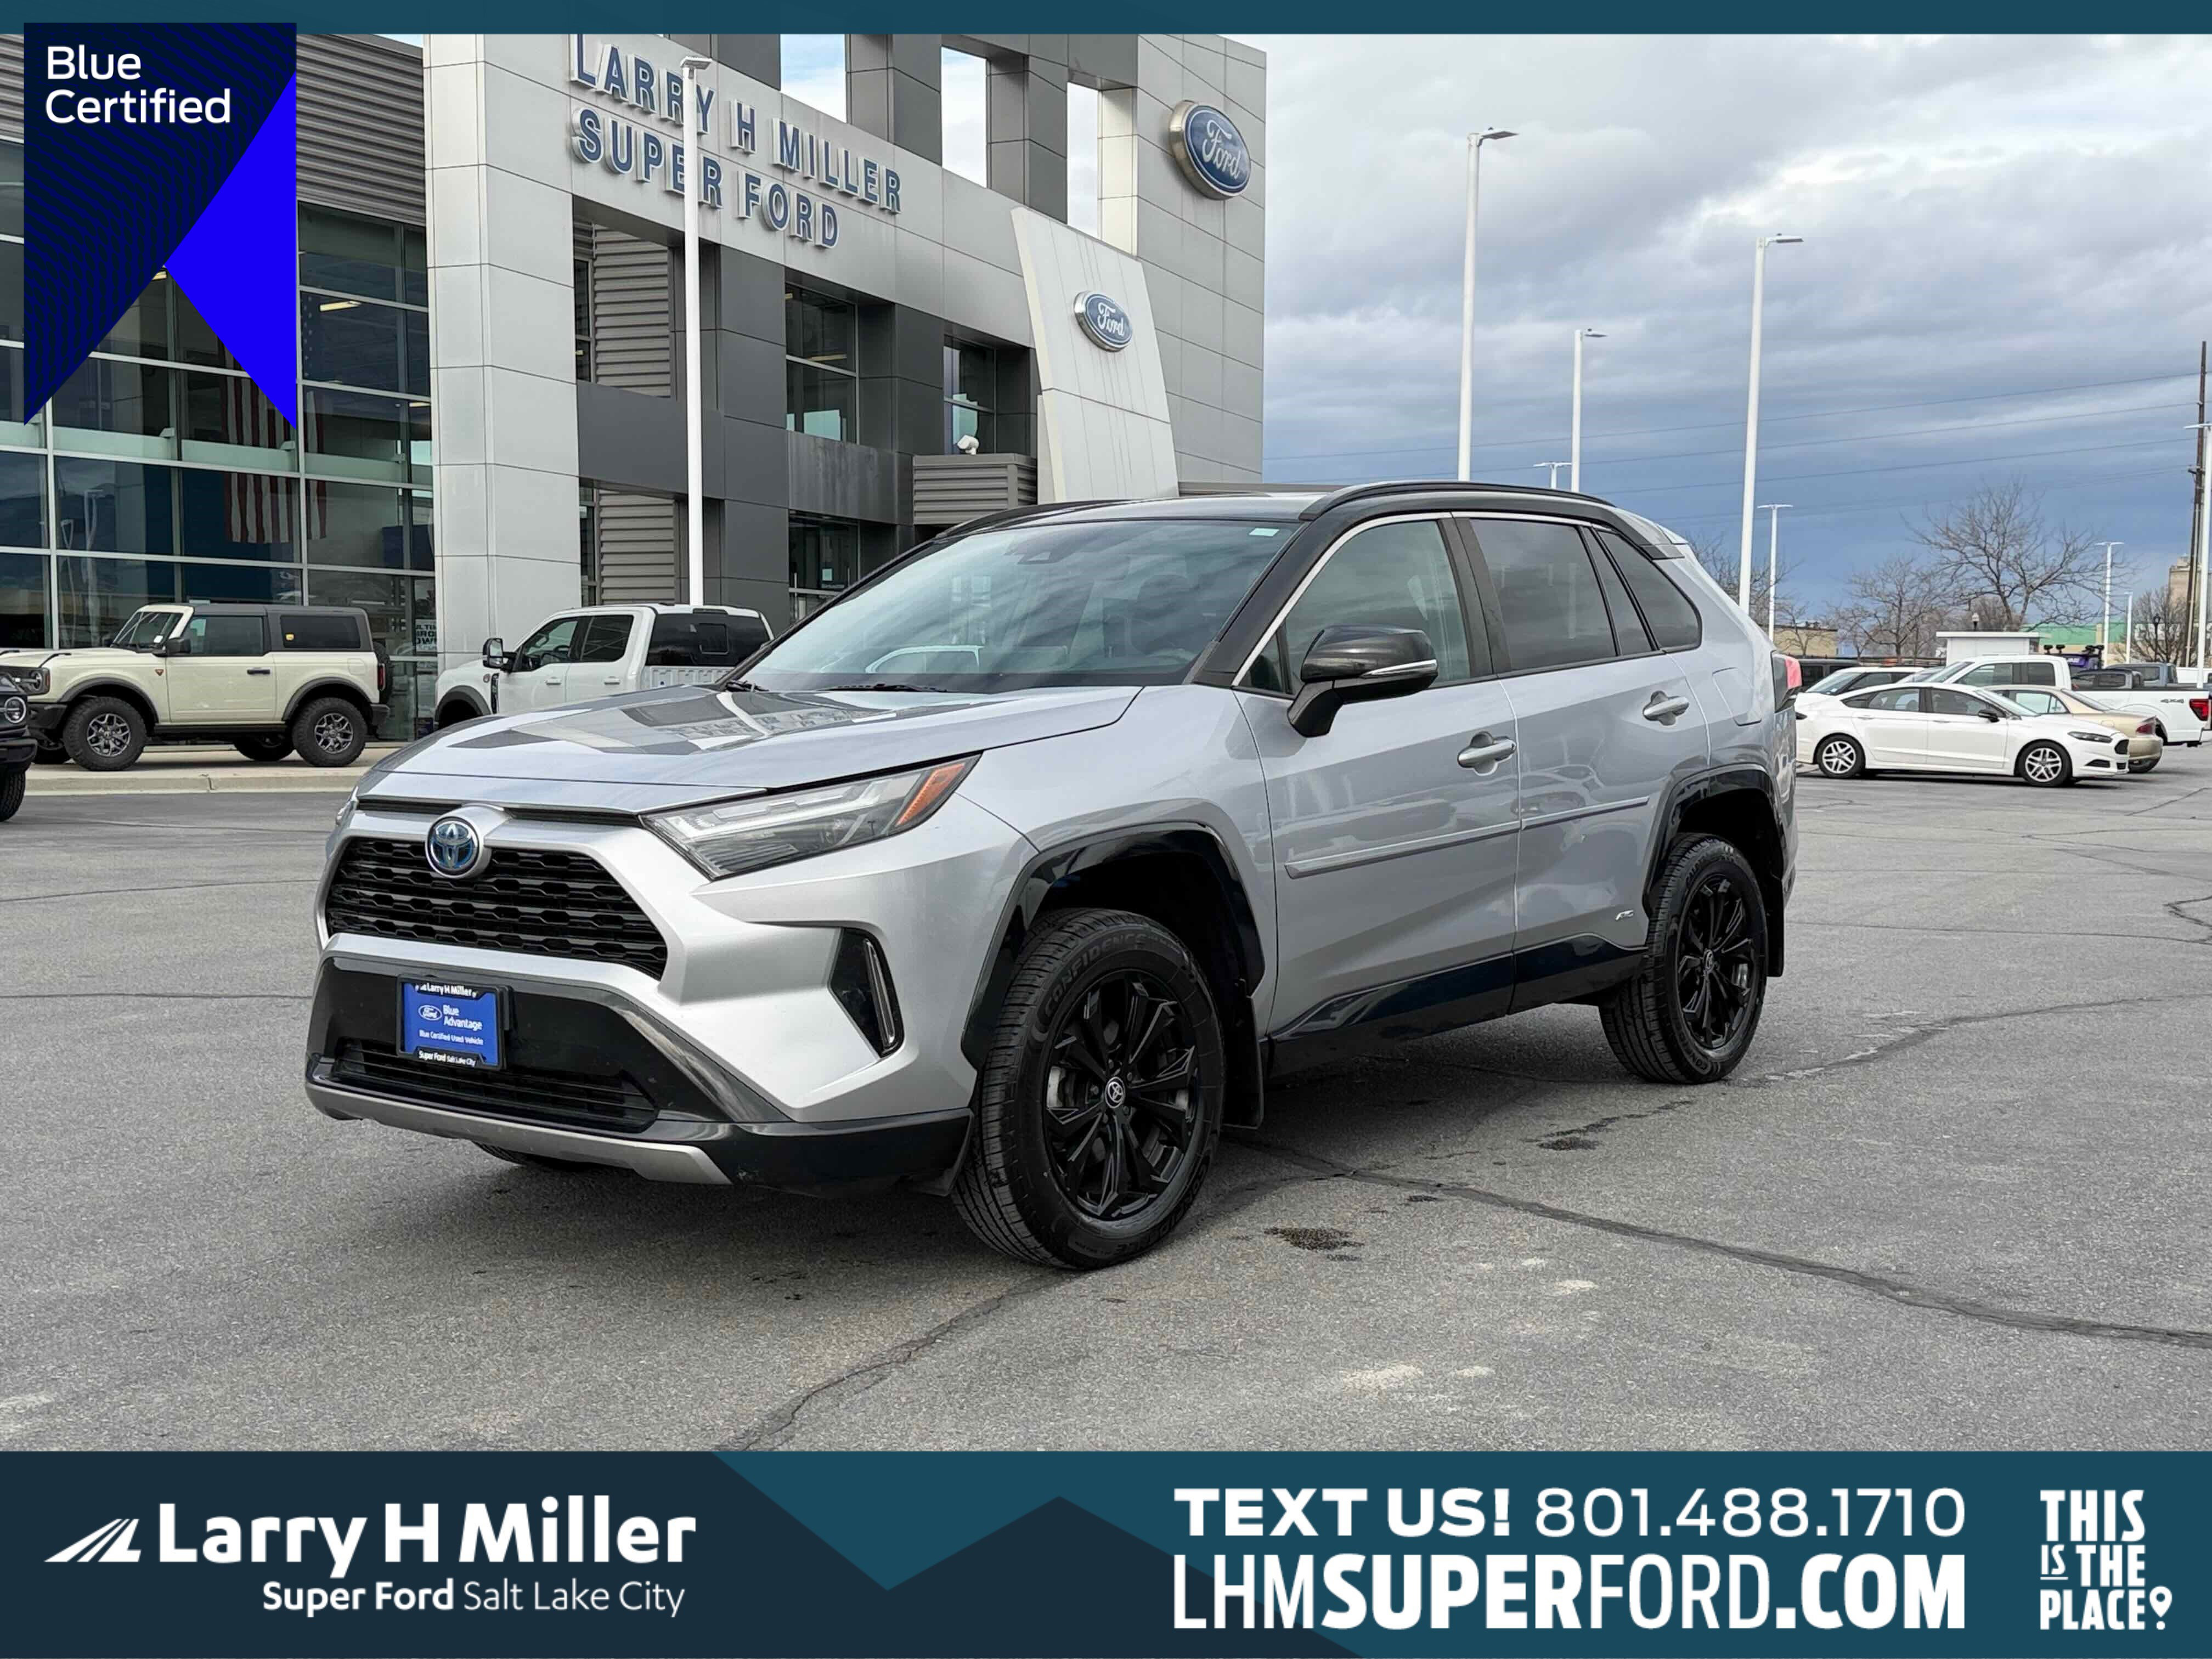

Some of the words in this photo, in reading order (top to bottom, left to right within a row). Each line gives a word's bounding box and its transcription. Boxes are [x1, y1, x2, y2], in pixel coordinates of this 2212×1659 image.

[571, 34, 715, 136] LARRY
[731, 99, 757, 154] H
[772, 117, 901, 213] MILLER
[1202, 119, 1243, 179] Ford
[572, 108, 723, 209] SUPER
[737, 171, 839, 249] FORD
[1097, 301, 1125, 337] Ford
[427, 983, 444, 995] Larry
[444, 985, 450, 994] H
[450, 985, 472, 996] Miller
[1045, 933, 1148, 1018] CONFIDENCE
[443, 1005, 459, 1016] Blue
[443, 1016, 483, 1031] Advantage
[419, 1050, 433, 1061] Super
[434, 1052, 446, 1063] Ford
